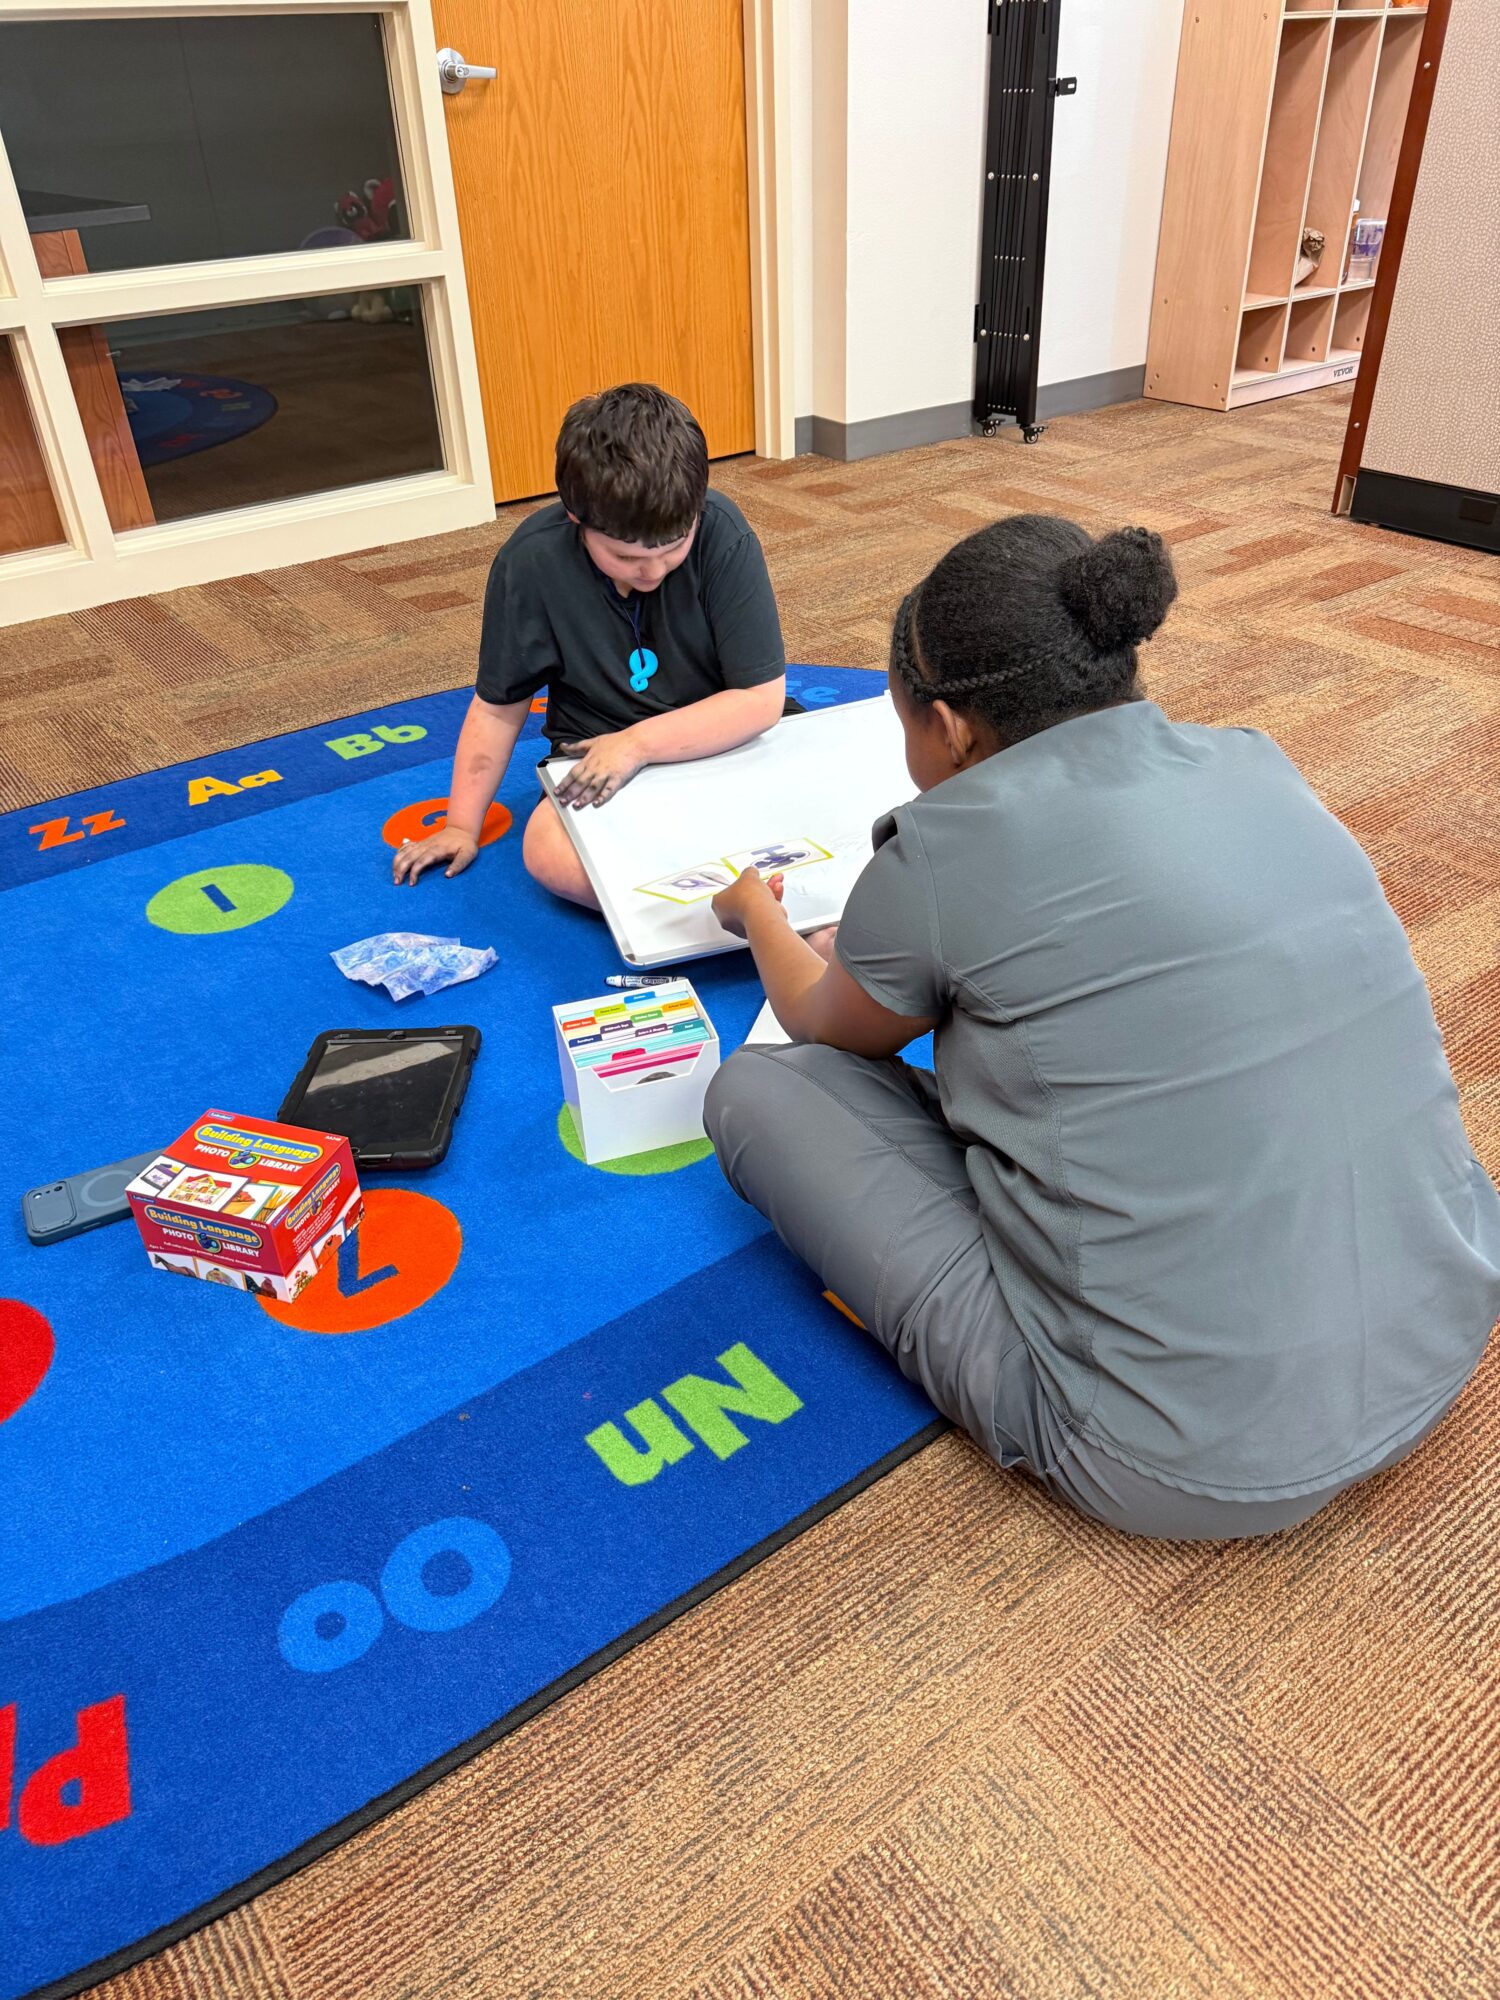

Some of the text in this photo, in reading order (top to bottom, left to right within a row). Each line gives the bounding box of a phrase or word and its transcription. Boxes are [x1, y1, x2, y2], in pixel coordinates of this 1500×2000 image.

[1333, 366, 1354, 378] VEVOR
[325, 725, 428, 760] Bb
[187, 769, 283, 806] Aa
[28, 810, 127, 851] Zz
[194, 1144, 303, 1173] PHOTO LIBRARY
[200, 1127, 318, 1160] Building Language
[286, 1197, 313, 1225] Building
[311, 1166, 340, 1199] Language
[148, 1208, 258, 1243] Building Language
[293, 1212, 311, 1232] PHOTO
[162, 1228, 260, 1257] PHOTO LIBRARY
[585, 1342, 804, 1486] Nn
[277, 1514, 514, 1674] Oo
[0, 1693, 132, 1847] P
